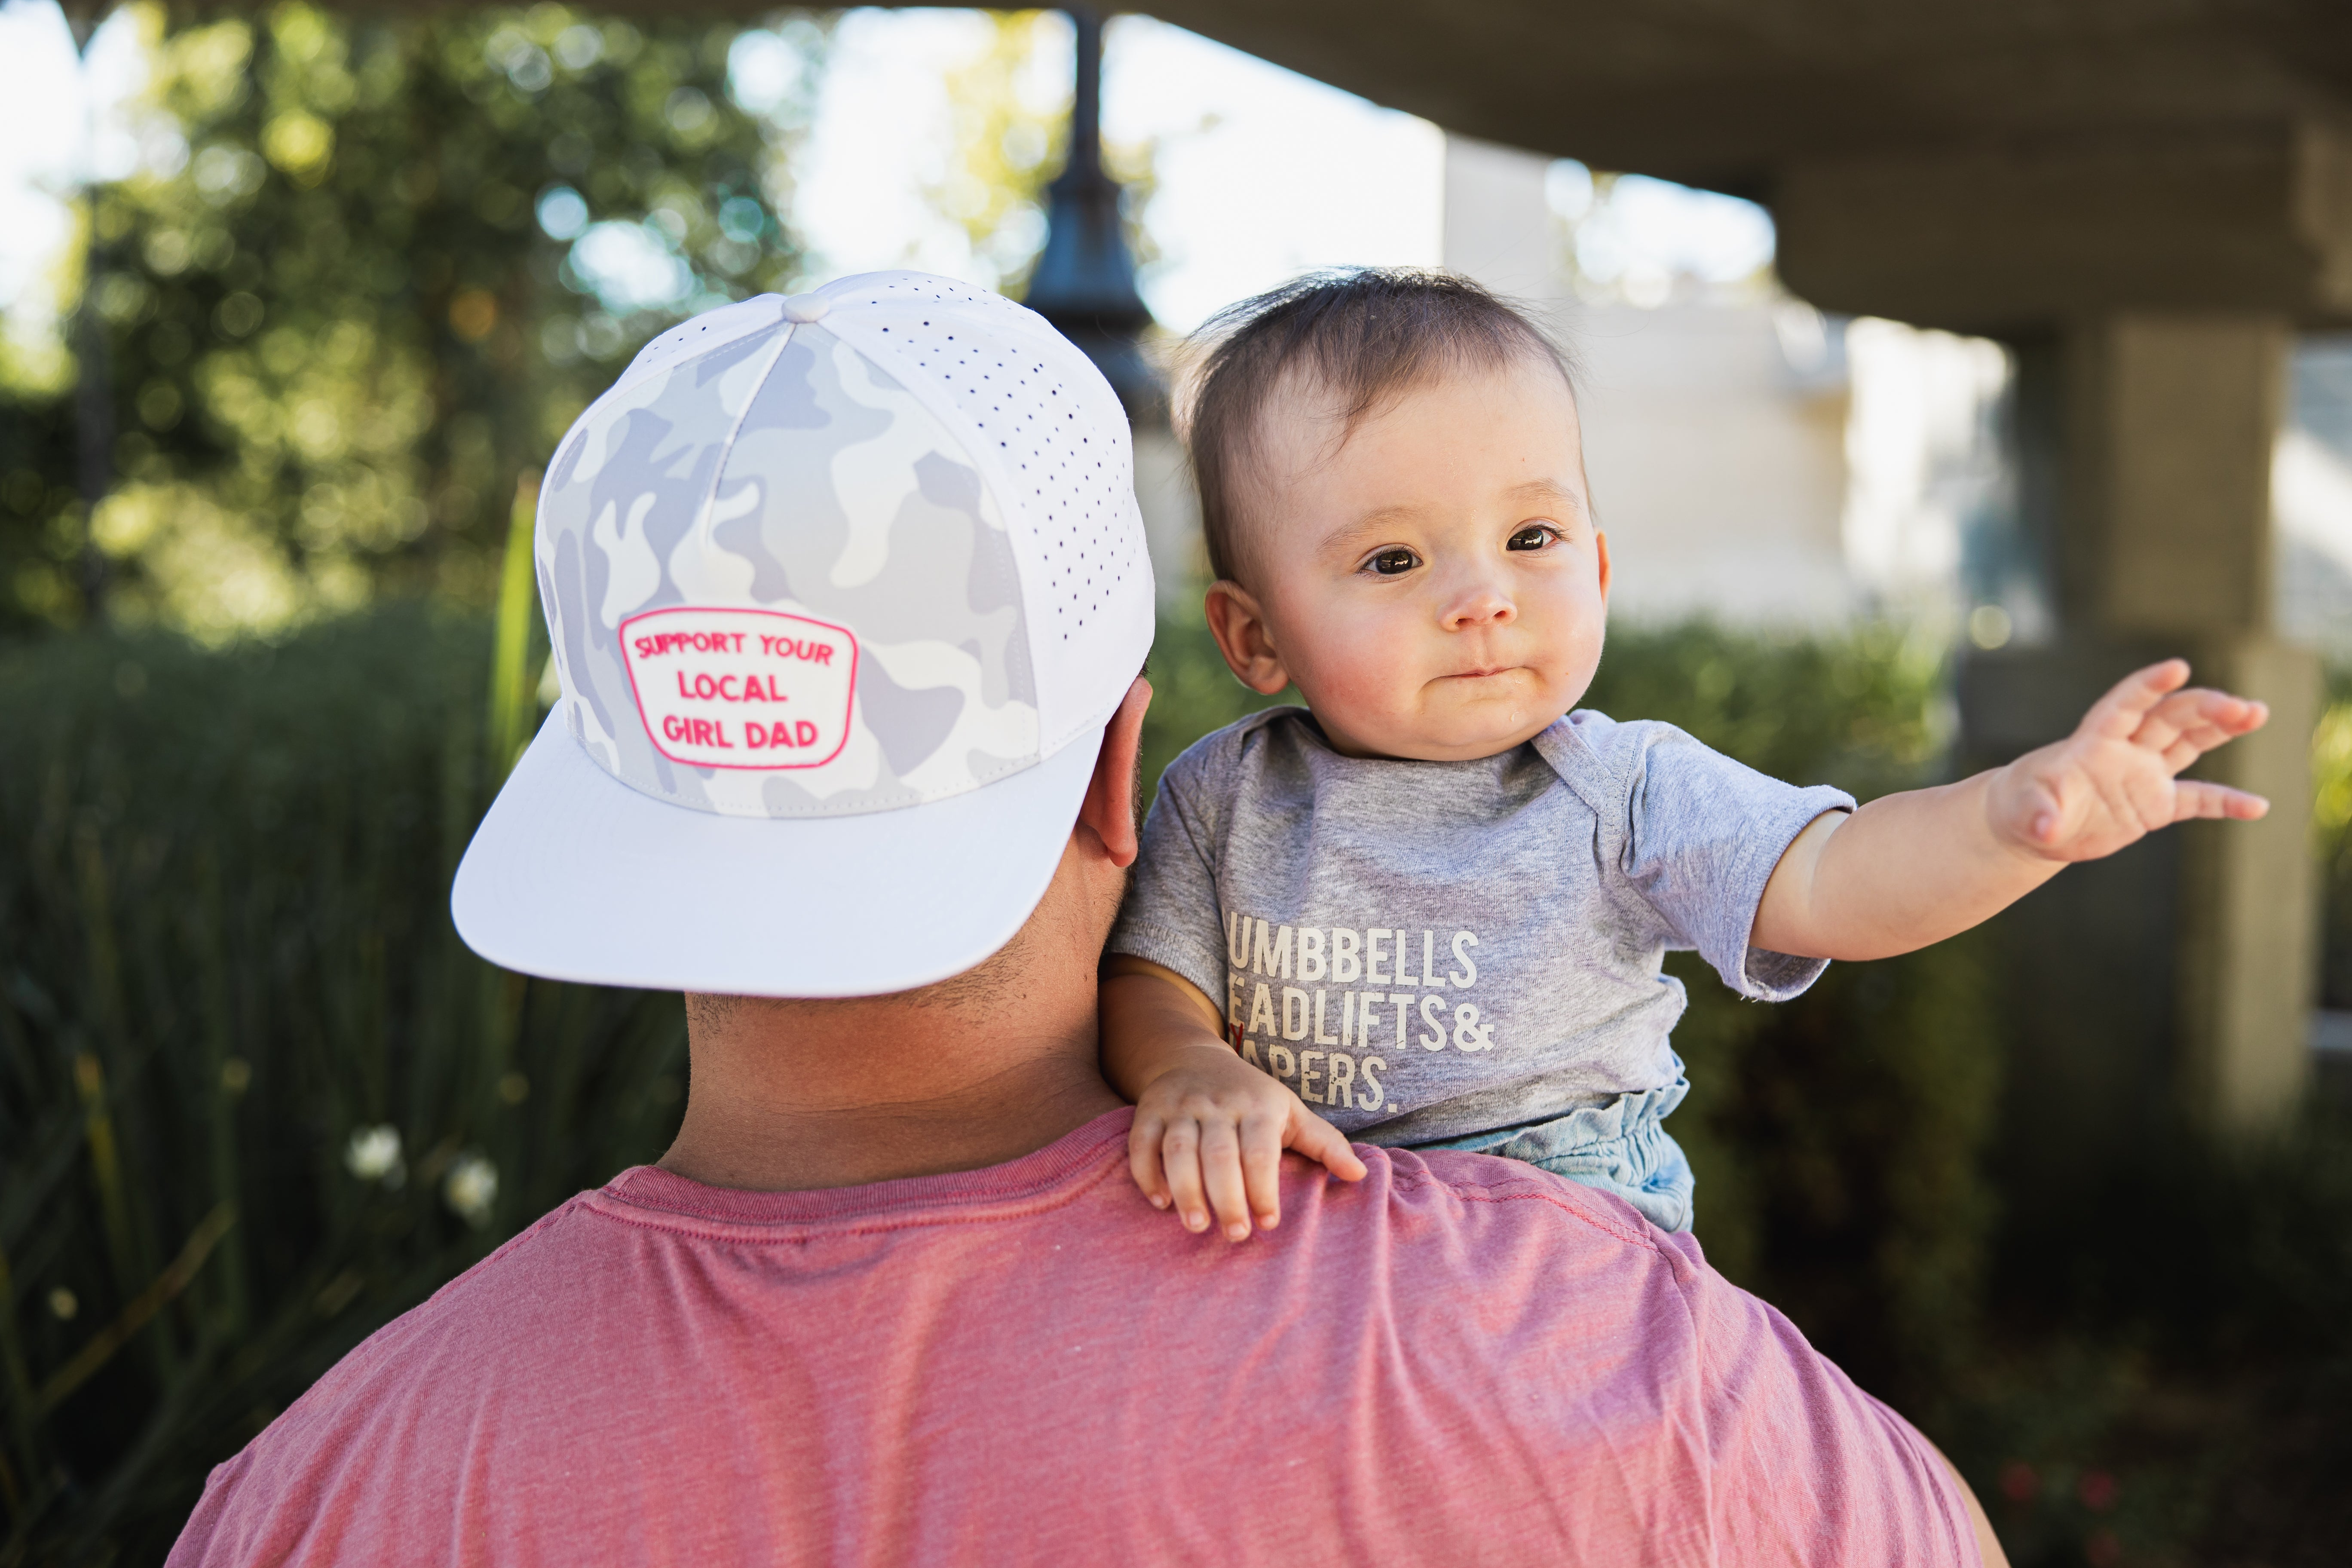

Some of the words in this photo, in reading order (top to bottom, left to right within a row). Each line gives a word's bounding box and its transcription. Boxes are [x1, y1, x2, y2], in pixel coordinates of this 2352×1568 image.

[634, 632, 747, 659] SUPPORT
[759, 634, 834, 666] YOUR
[677, 670, 788, 703] LOCAL
[663, 714, 734, 749] GIRL
[745, 720, 818, 750] DAD
[1229, 911, 1479, 988] UMBBELLS
[1229, 1032, 1397, 1113] APERS.
